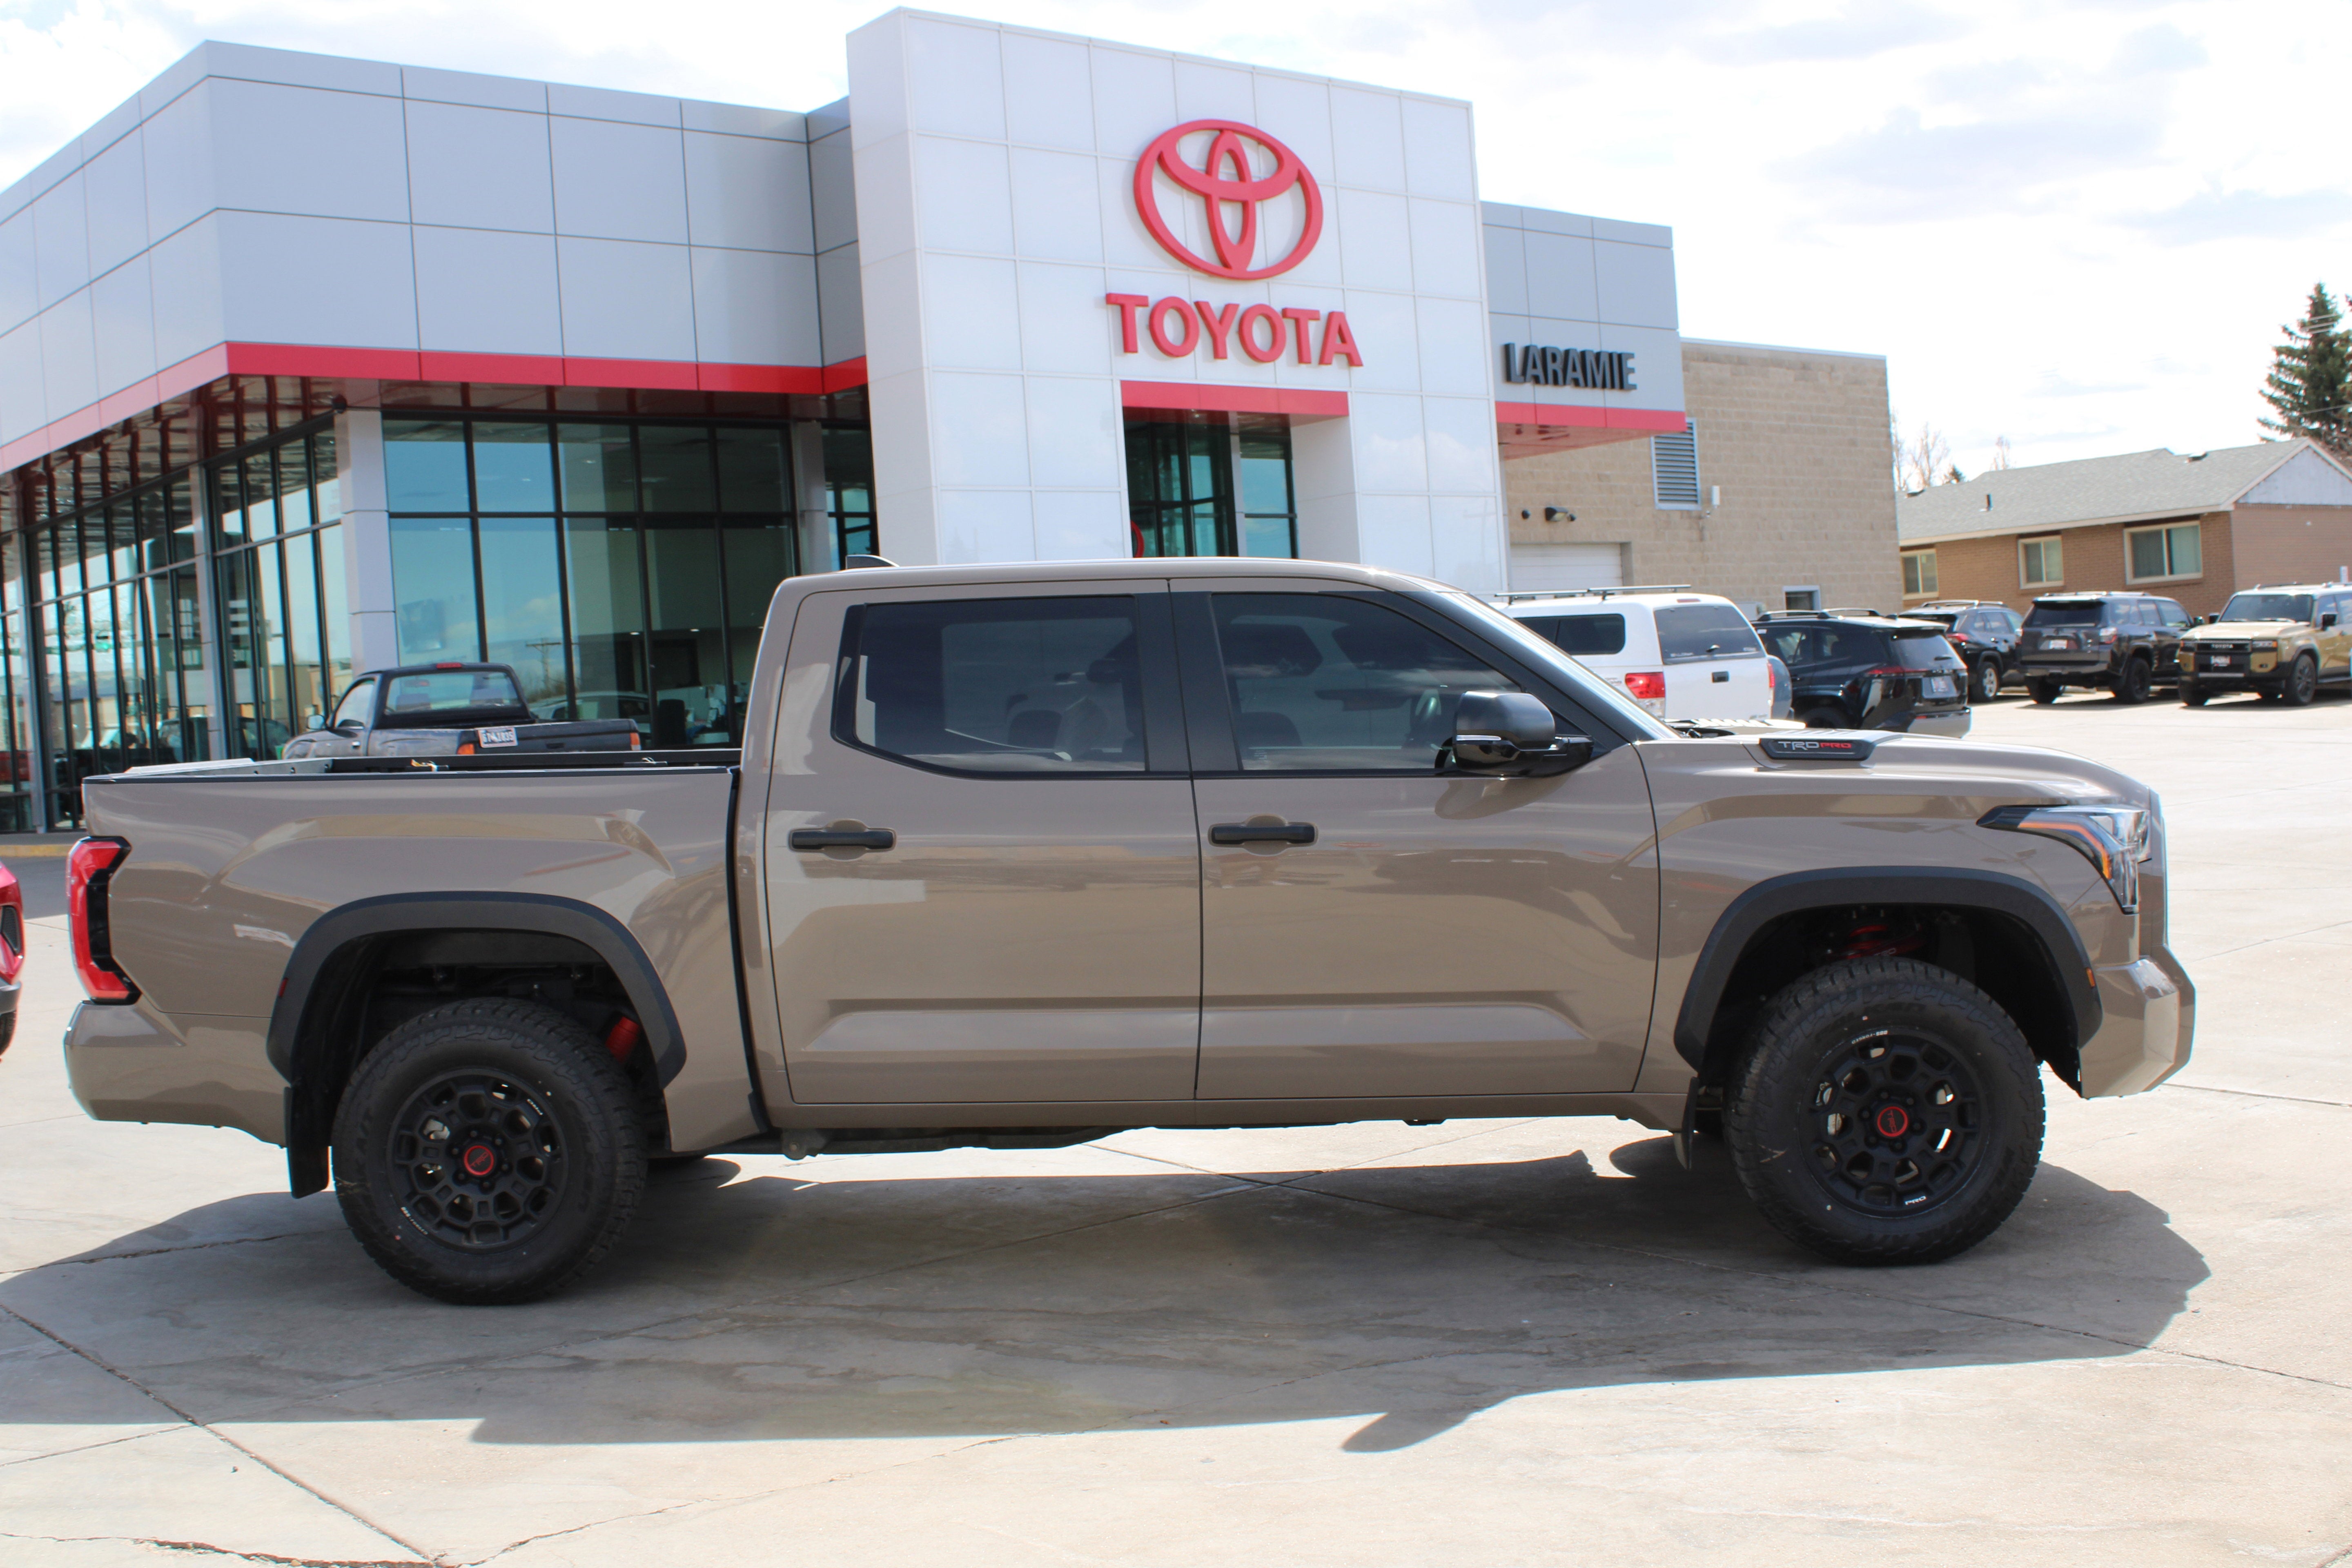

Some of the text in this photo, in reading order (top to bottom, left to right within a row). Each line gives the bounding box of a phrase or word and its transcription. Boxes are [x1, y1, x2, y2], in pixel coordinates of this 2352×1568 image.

[1106, 292, 1363, 367] TOYOTA
[1504, 343, 1637, 391] LARAMIE
[1778, 741, 1820, 751] TRD
[1887, 1109, 1897, 1133] TRD
[470, 1152, 489, 1167] TRD
[1905, 1196, 1926, 1205] PRO
